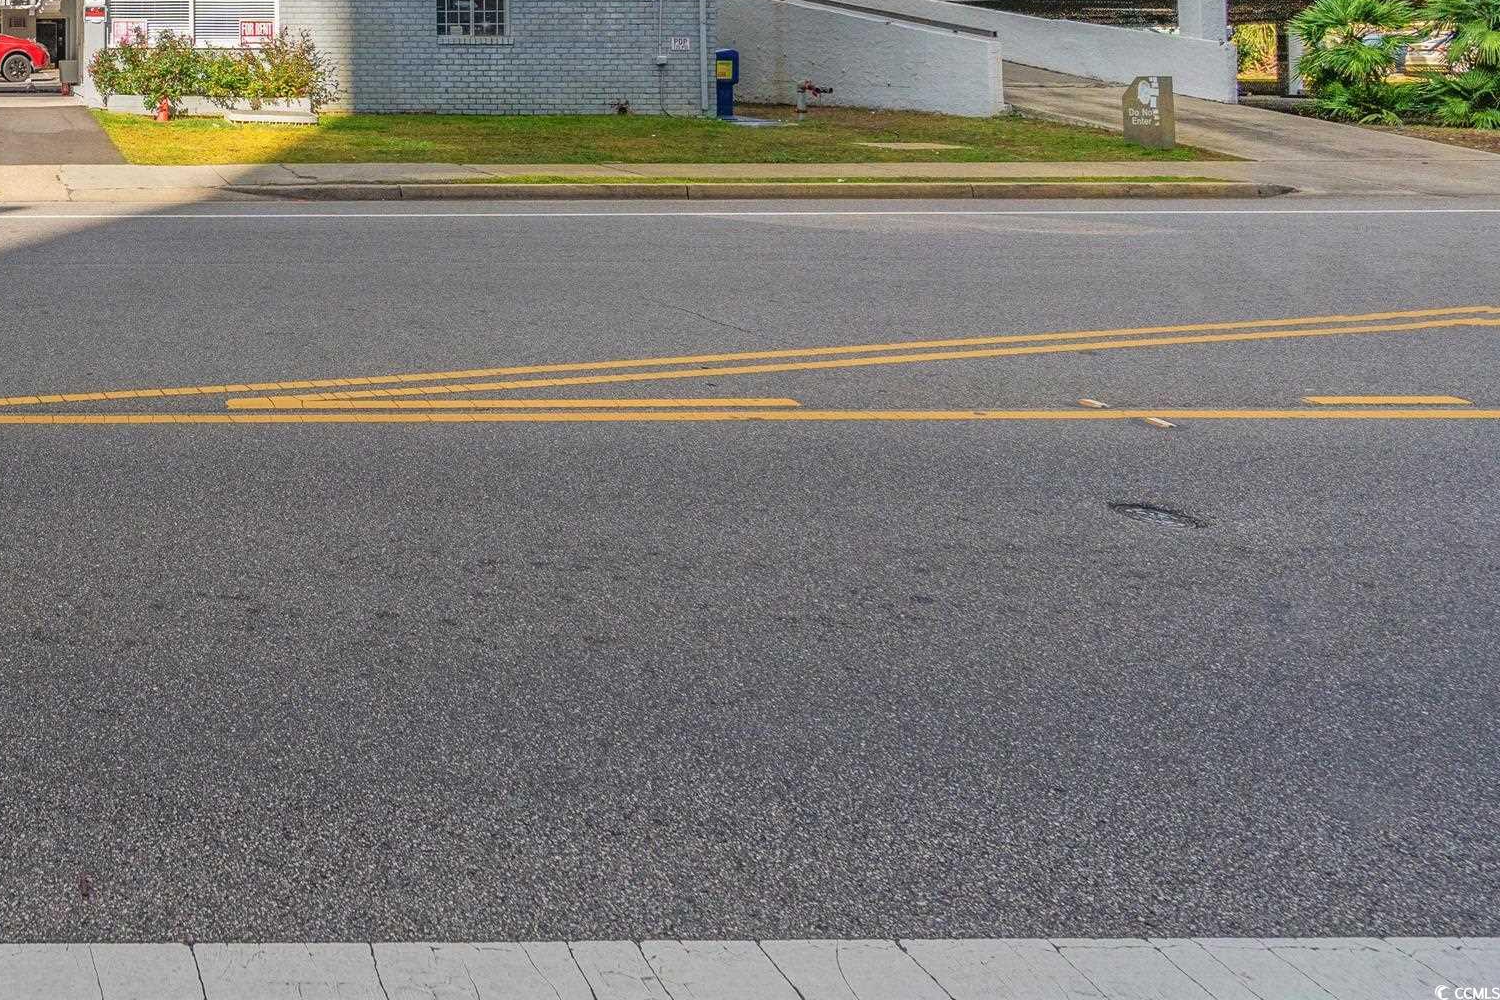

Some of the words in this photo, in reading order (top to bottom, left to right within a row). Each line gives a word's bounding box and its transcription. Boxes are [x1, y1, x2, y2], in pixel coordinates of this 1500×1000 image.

[242, 22, 254, 36] FOR
[255, 22, 273, 36] RENT
[1128, 108, 1139, 116] Do
[1131, 116, 1152, 126] Enter
